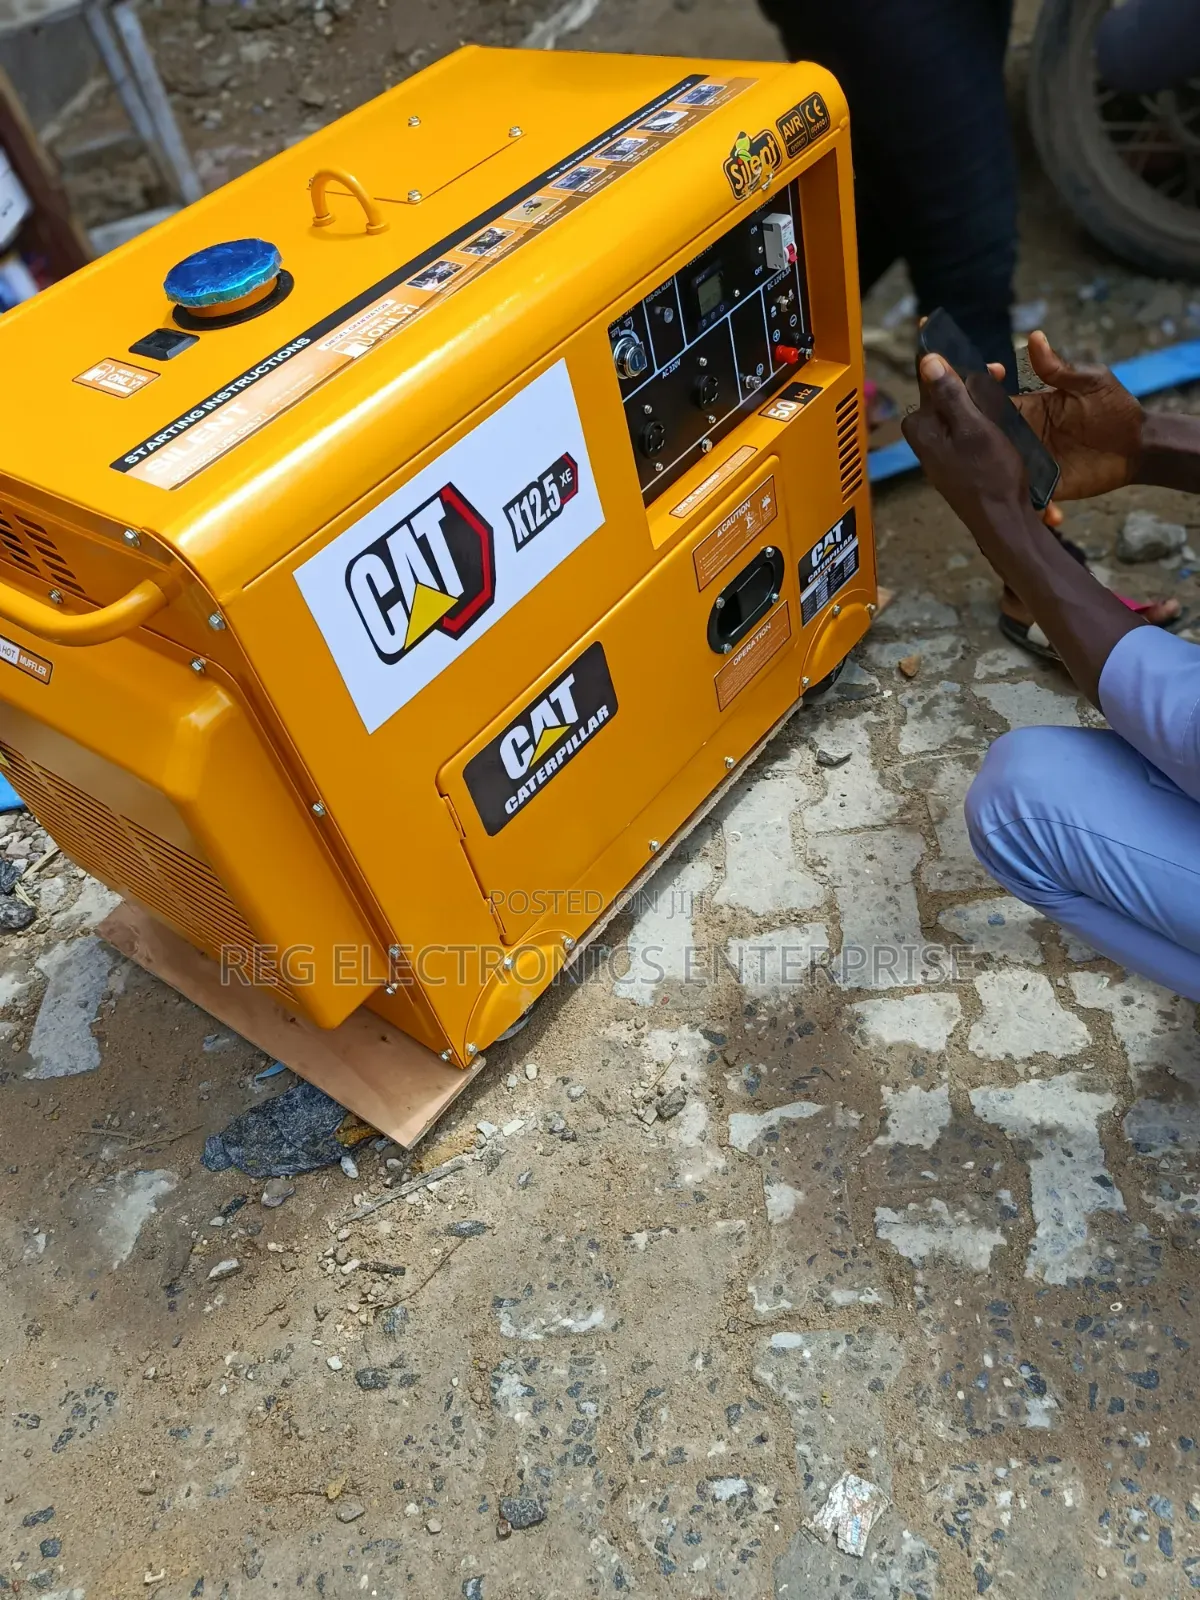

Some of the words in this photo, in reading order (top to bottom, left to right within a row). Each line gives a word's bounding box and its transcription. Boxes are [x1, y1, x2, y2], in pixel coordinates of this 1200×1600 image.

[782, 116, 803, 140] AVR
[730, 135, 777, 190] Silent
[750, 225, 758, 235] ON
[754, 265, 763, 276] OFF
[662, 368, 669, 379] AC
[124, 410, 205, 464] STARTING
[202, 337, 311, 411] INSTRUCTIONS
[767, 401, 797, 419] 50
[794, 388, 813, 401] Hz
[146, 402, 248, 474] SILENT
[559, 467, 574, 488] XE
[508, 472, 561, 545] X12.5
[721, 500, 751, 532] CAUTION
[808, 533, 853, 583] CATERPILLAR
[811, 520, 844, 568] CAT
[349, 497, 465, 656] CAT
[2, 645, 16, 659] HOT
[733, 622, 772, 666] OPERATION
[499, 672, 578, 781] CAT
[504, 703, 610, 816] CATERPILLAR
